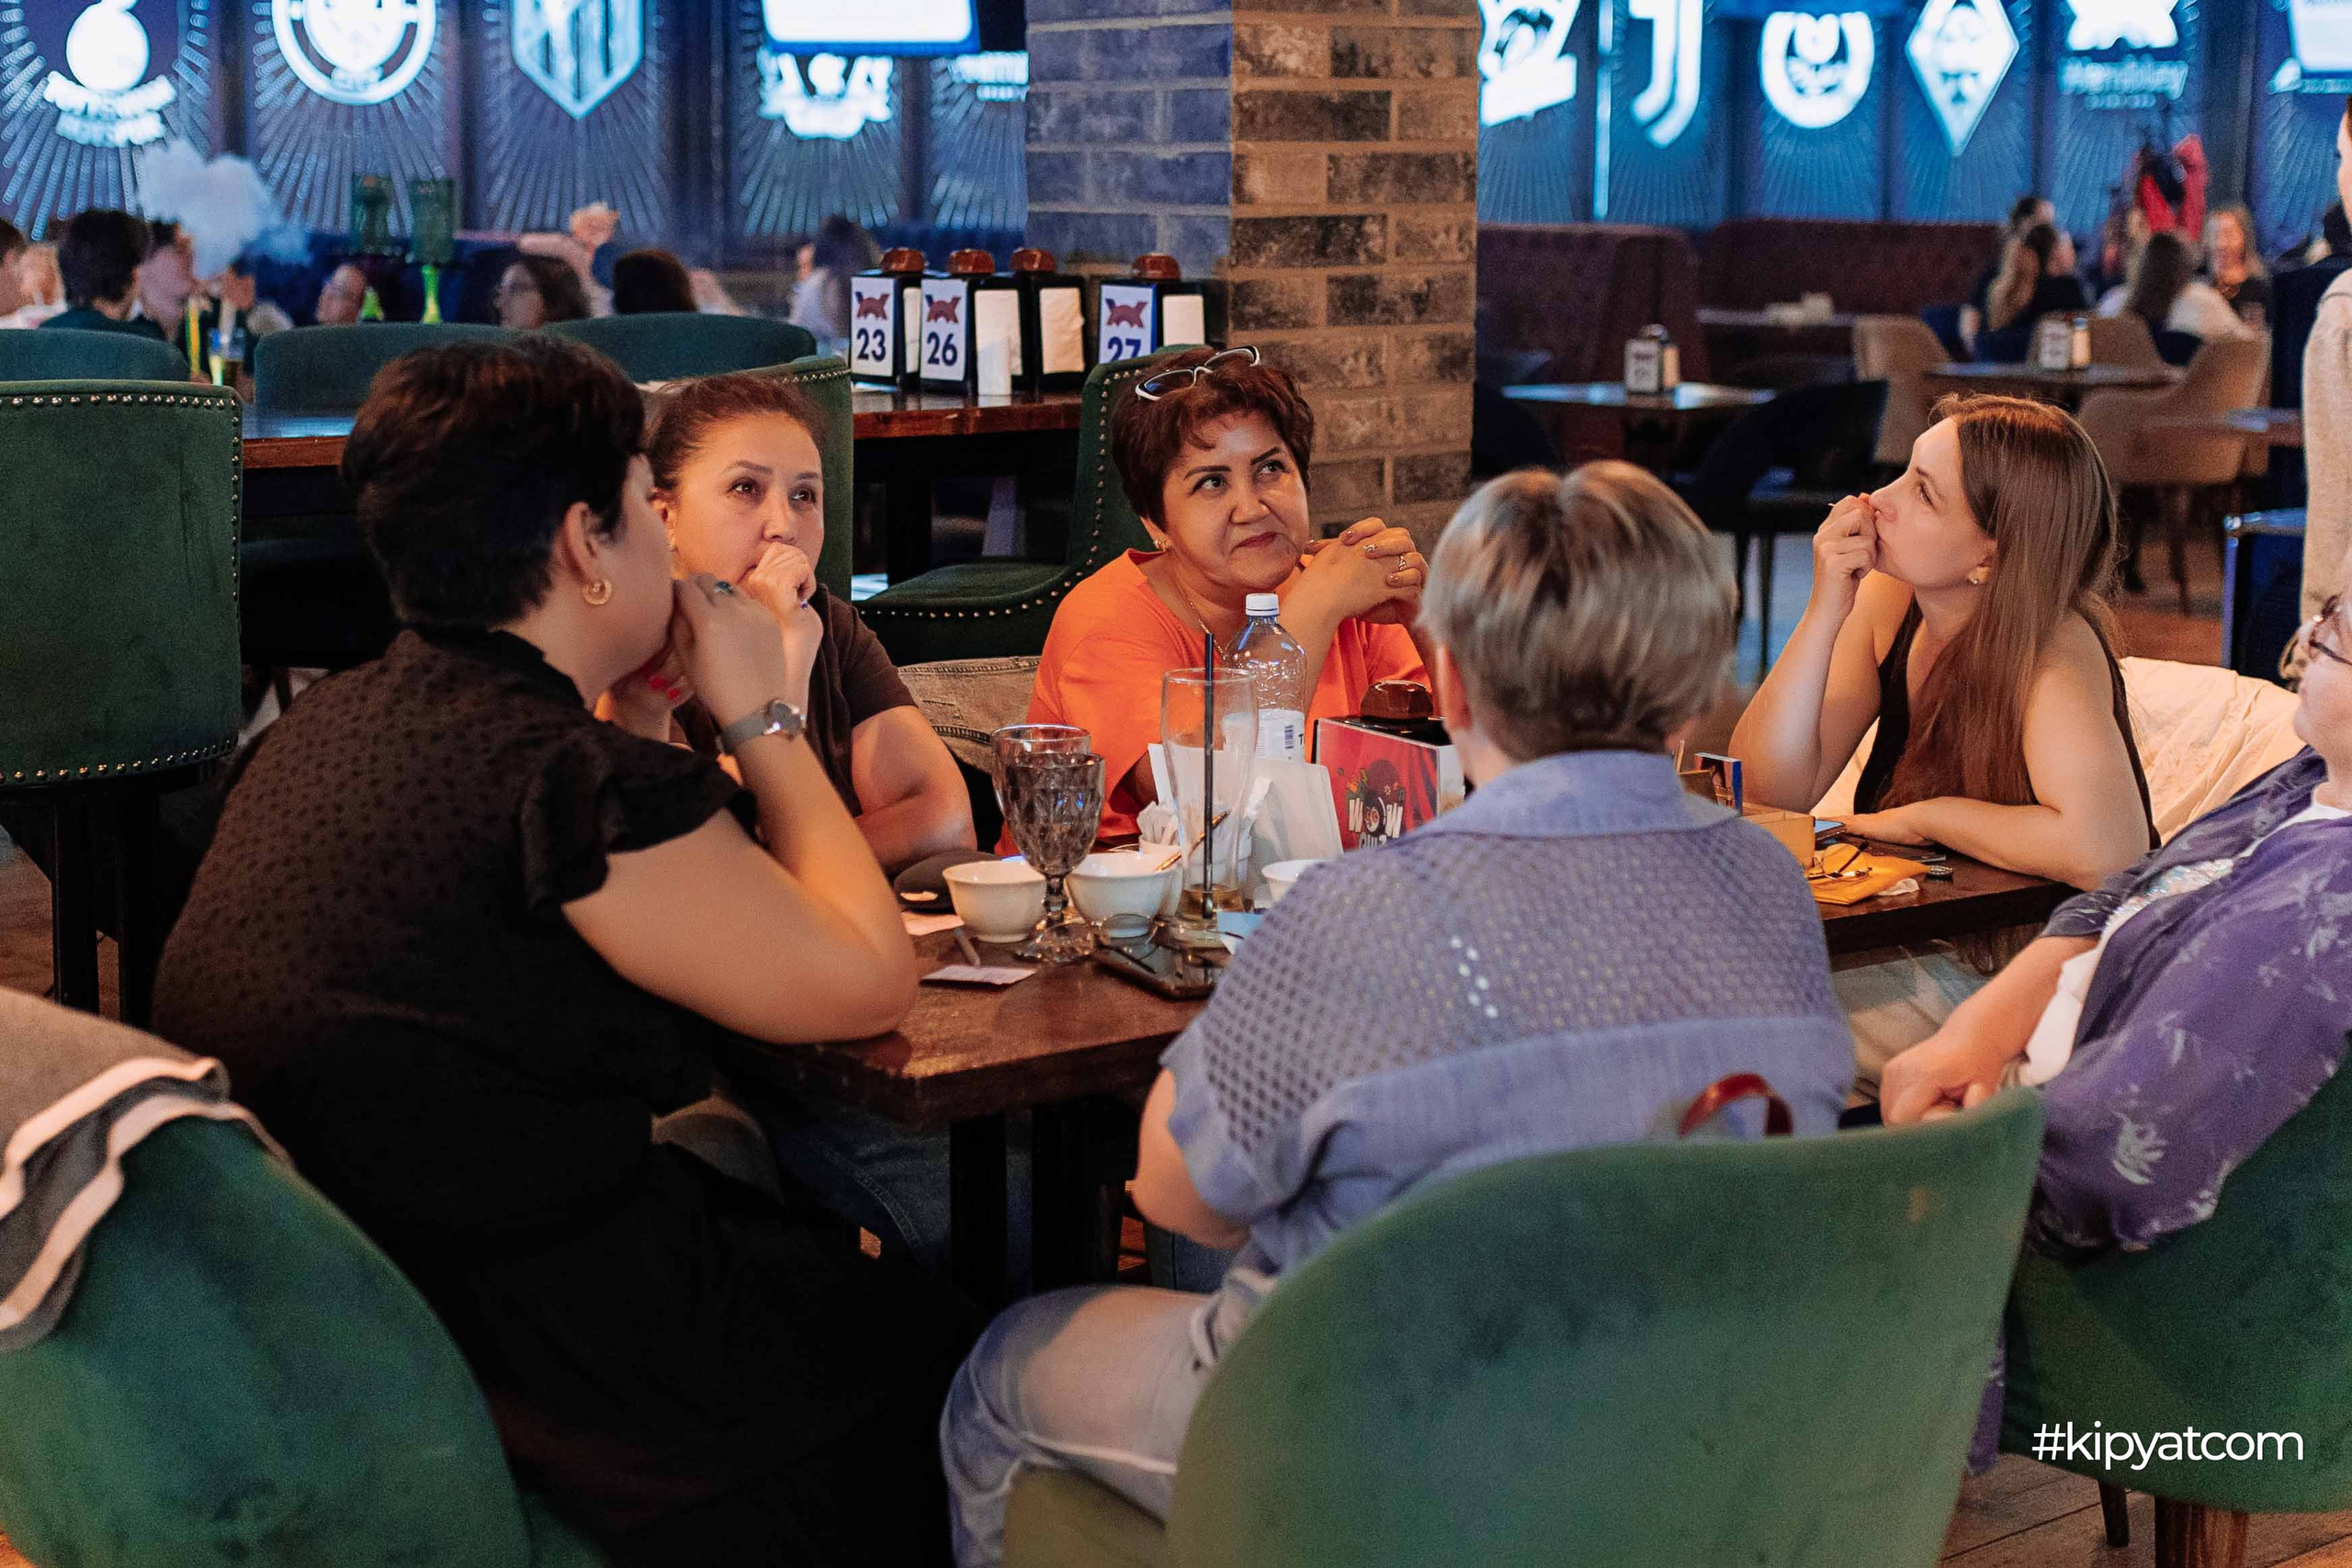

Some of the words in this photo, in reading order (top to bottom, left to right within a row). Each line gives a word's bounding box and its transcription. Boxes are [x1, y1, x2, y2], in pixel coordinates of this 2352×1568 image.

[856, 327, 887, 362] 23
[926, 331, 958, 367] 26
[1107, 336, 1142, 362] 27
